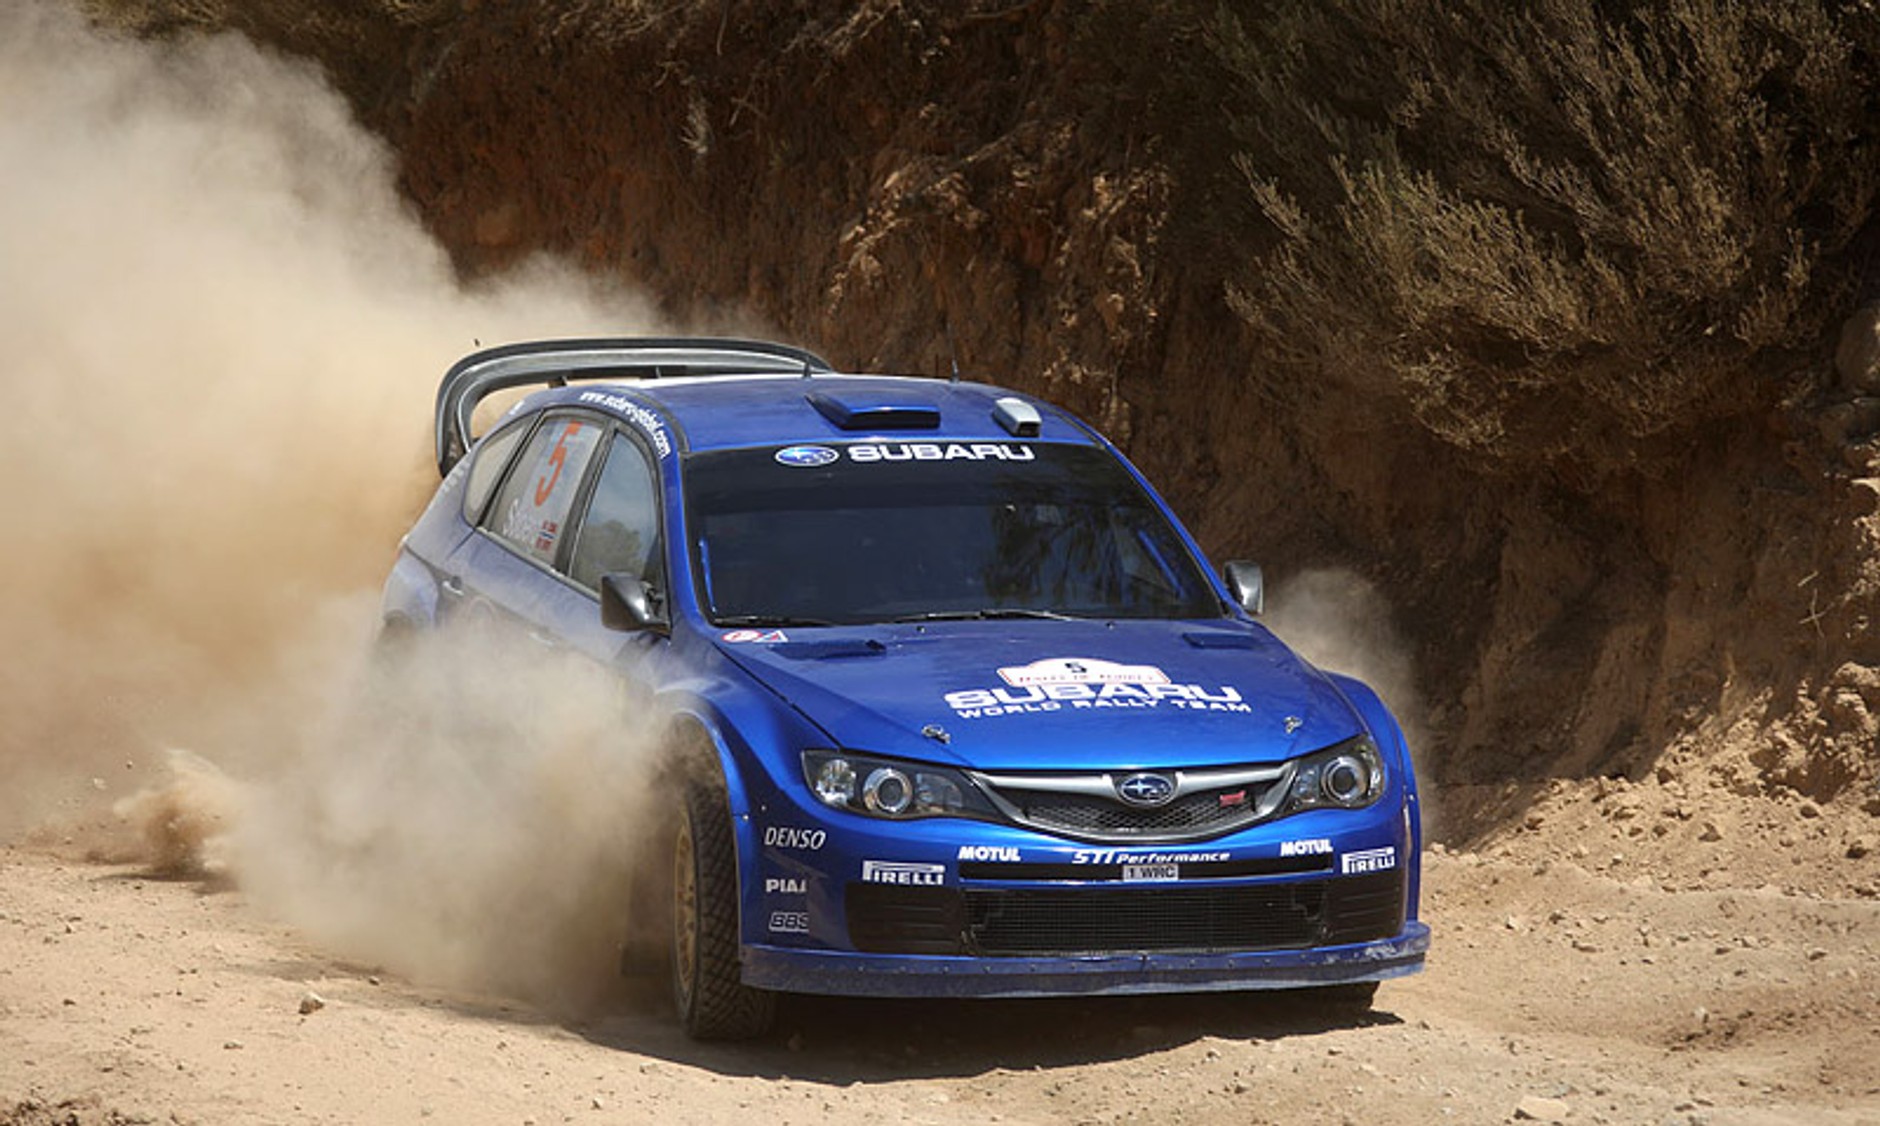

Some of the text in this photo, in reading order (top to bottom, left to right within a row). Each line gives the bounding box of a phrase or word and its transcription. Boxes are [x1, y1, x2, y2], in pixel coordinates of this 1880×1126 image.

[535, 420, 584, 507] 5
[849, 445, 1034, 462] SUBARU
[1065, 662, 1088, 673] 5
[944, 684, 1242, 709] SUBARU
[957, 699, 1252, 719] WORLD RALLY TEAM
[764, 827, 826, 850] DENSO
[1280, 839, 1334, 857] MOTUL
[957, 846, 1021, 862] MOTUL
[1071, 850, 1231, 865] STI Performance
[1341, 847, 1396, 875] PIRELLI
[862, 860, 946, 886] PIRELLI
